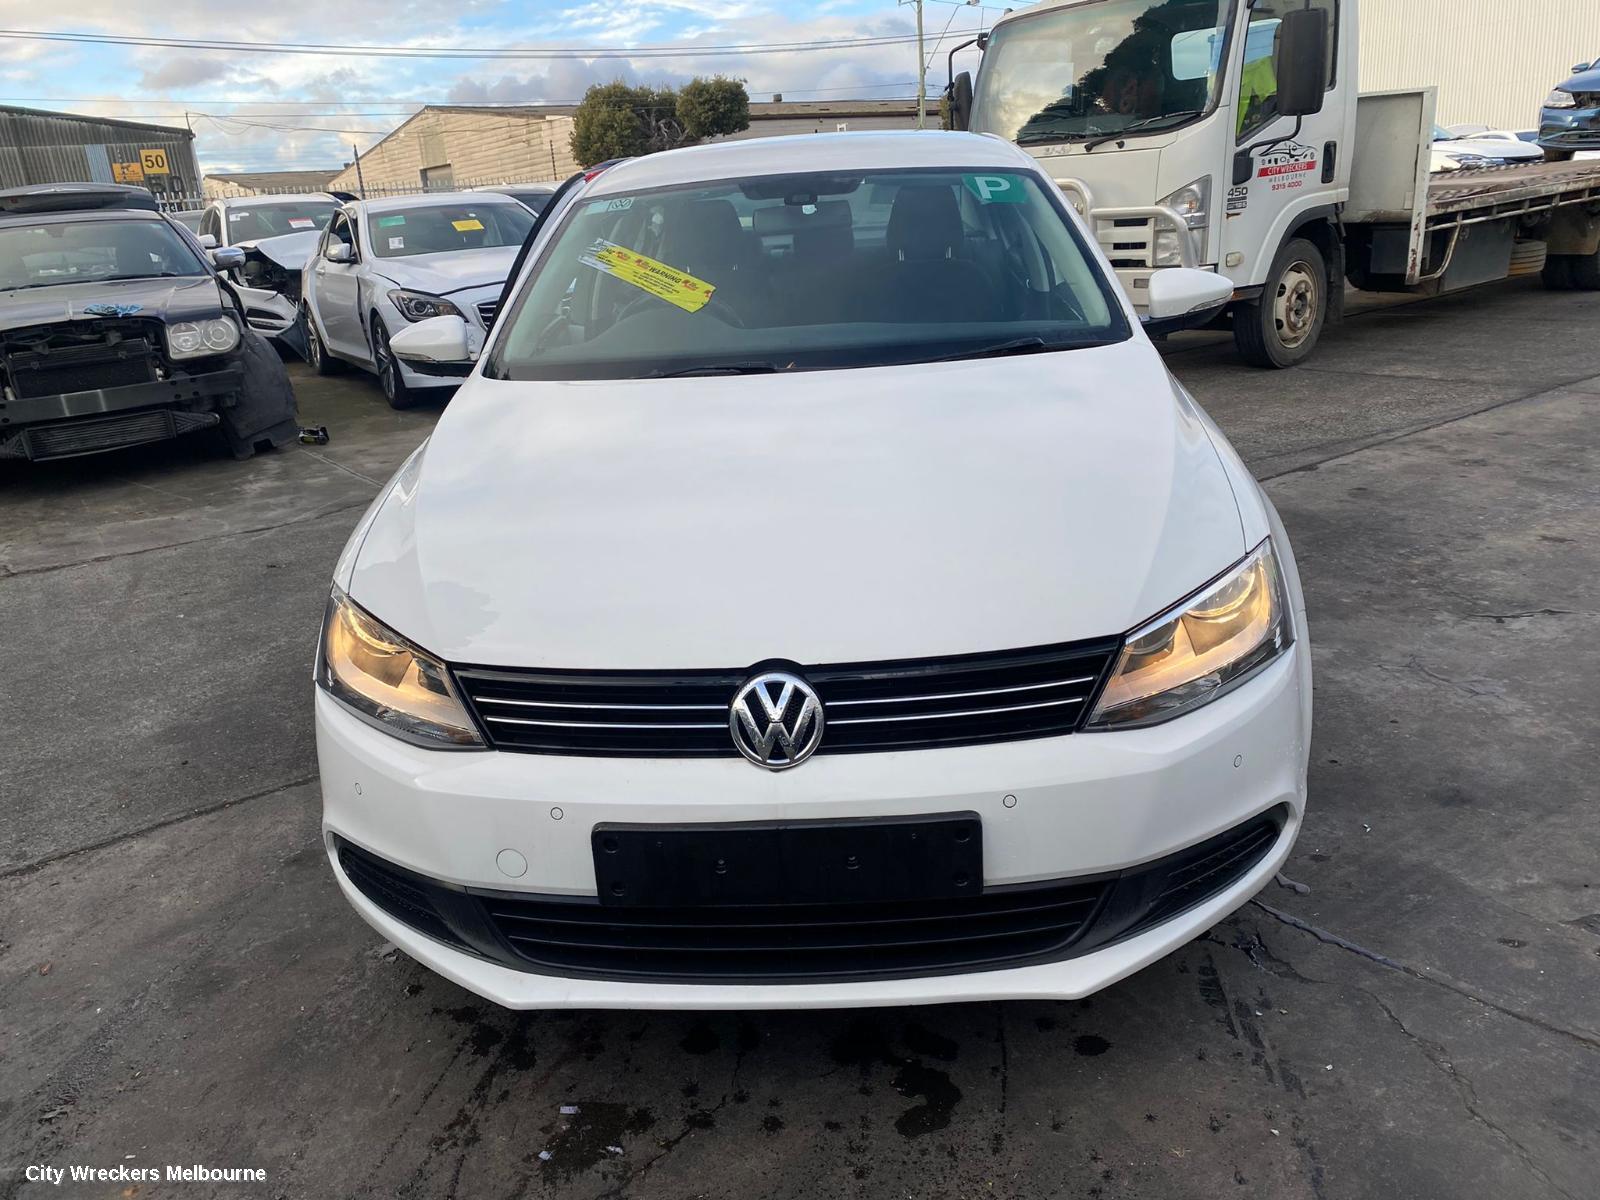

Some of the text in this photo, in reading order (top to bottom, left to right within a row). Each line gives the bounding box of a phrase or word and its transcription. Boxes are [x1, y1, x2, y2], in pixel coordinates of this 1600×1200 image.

[145, 154, 165, 169] 50
[1268, 162, 1308, 175] CITY WRECKERS
[1268, 173, 1307, 182] MELBOURNE
[973, 176, 1011, 199] P
[1227, 187, 1248, 196] 450
[648, 266, 682, 284] WARNING
[729, 672, 825, 769] VW
